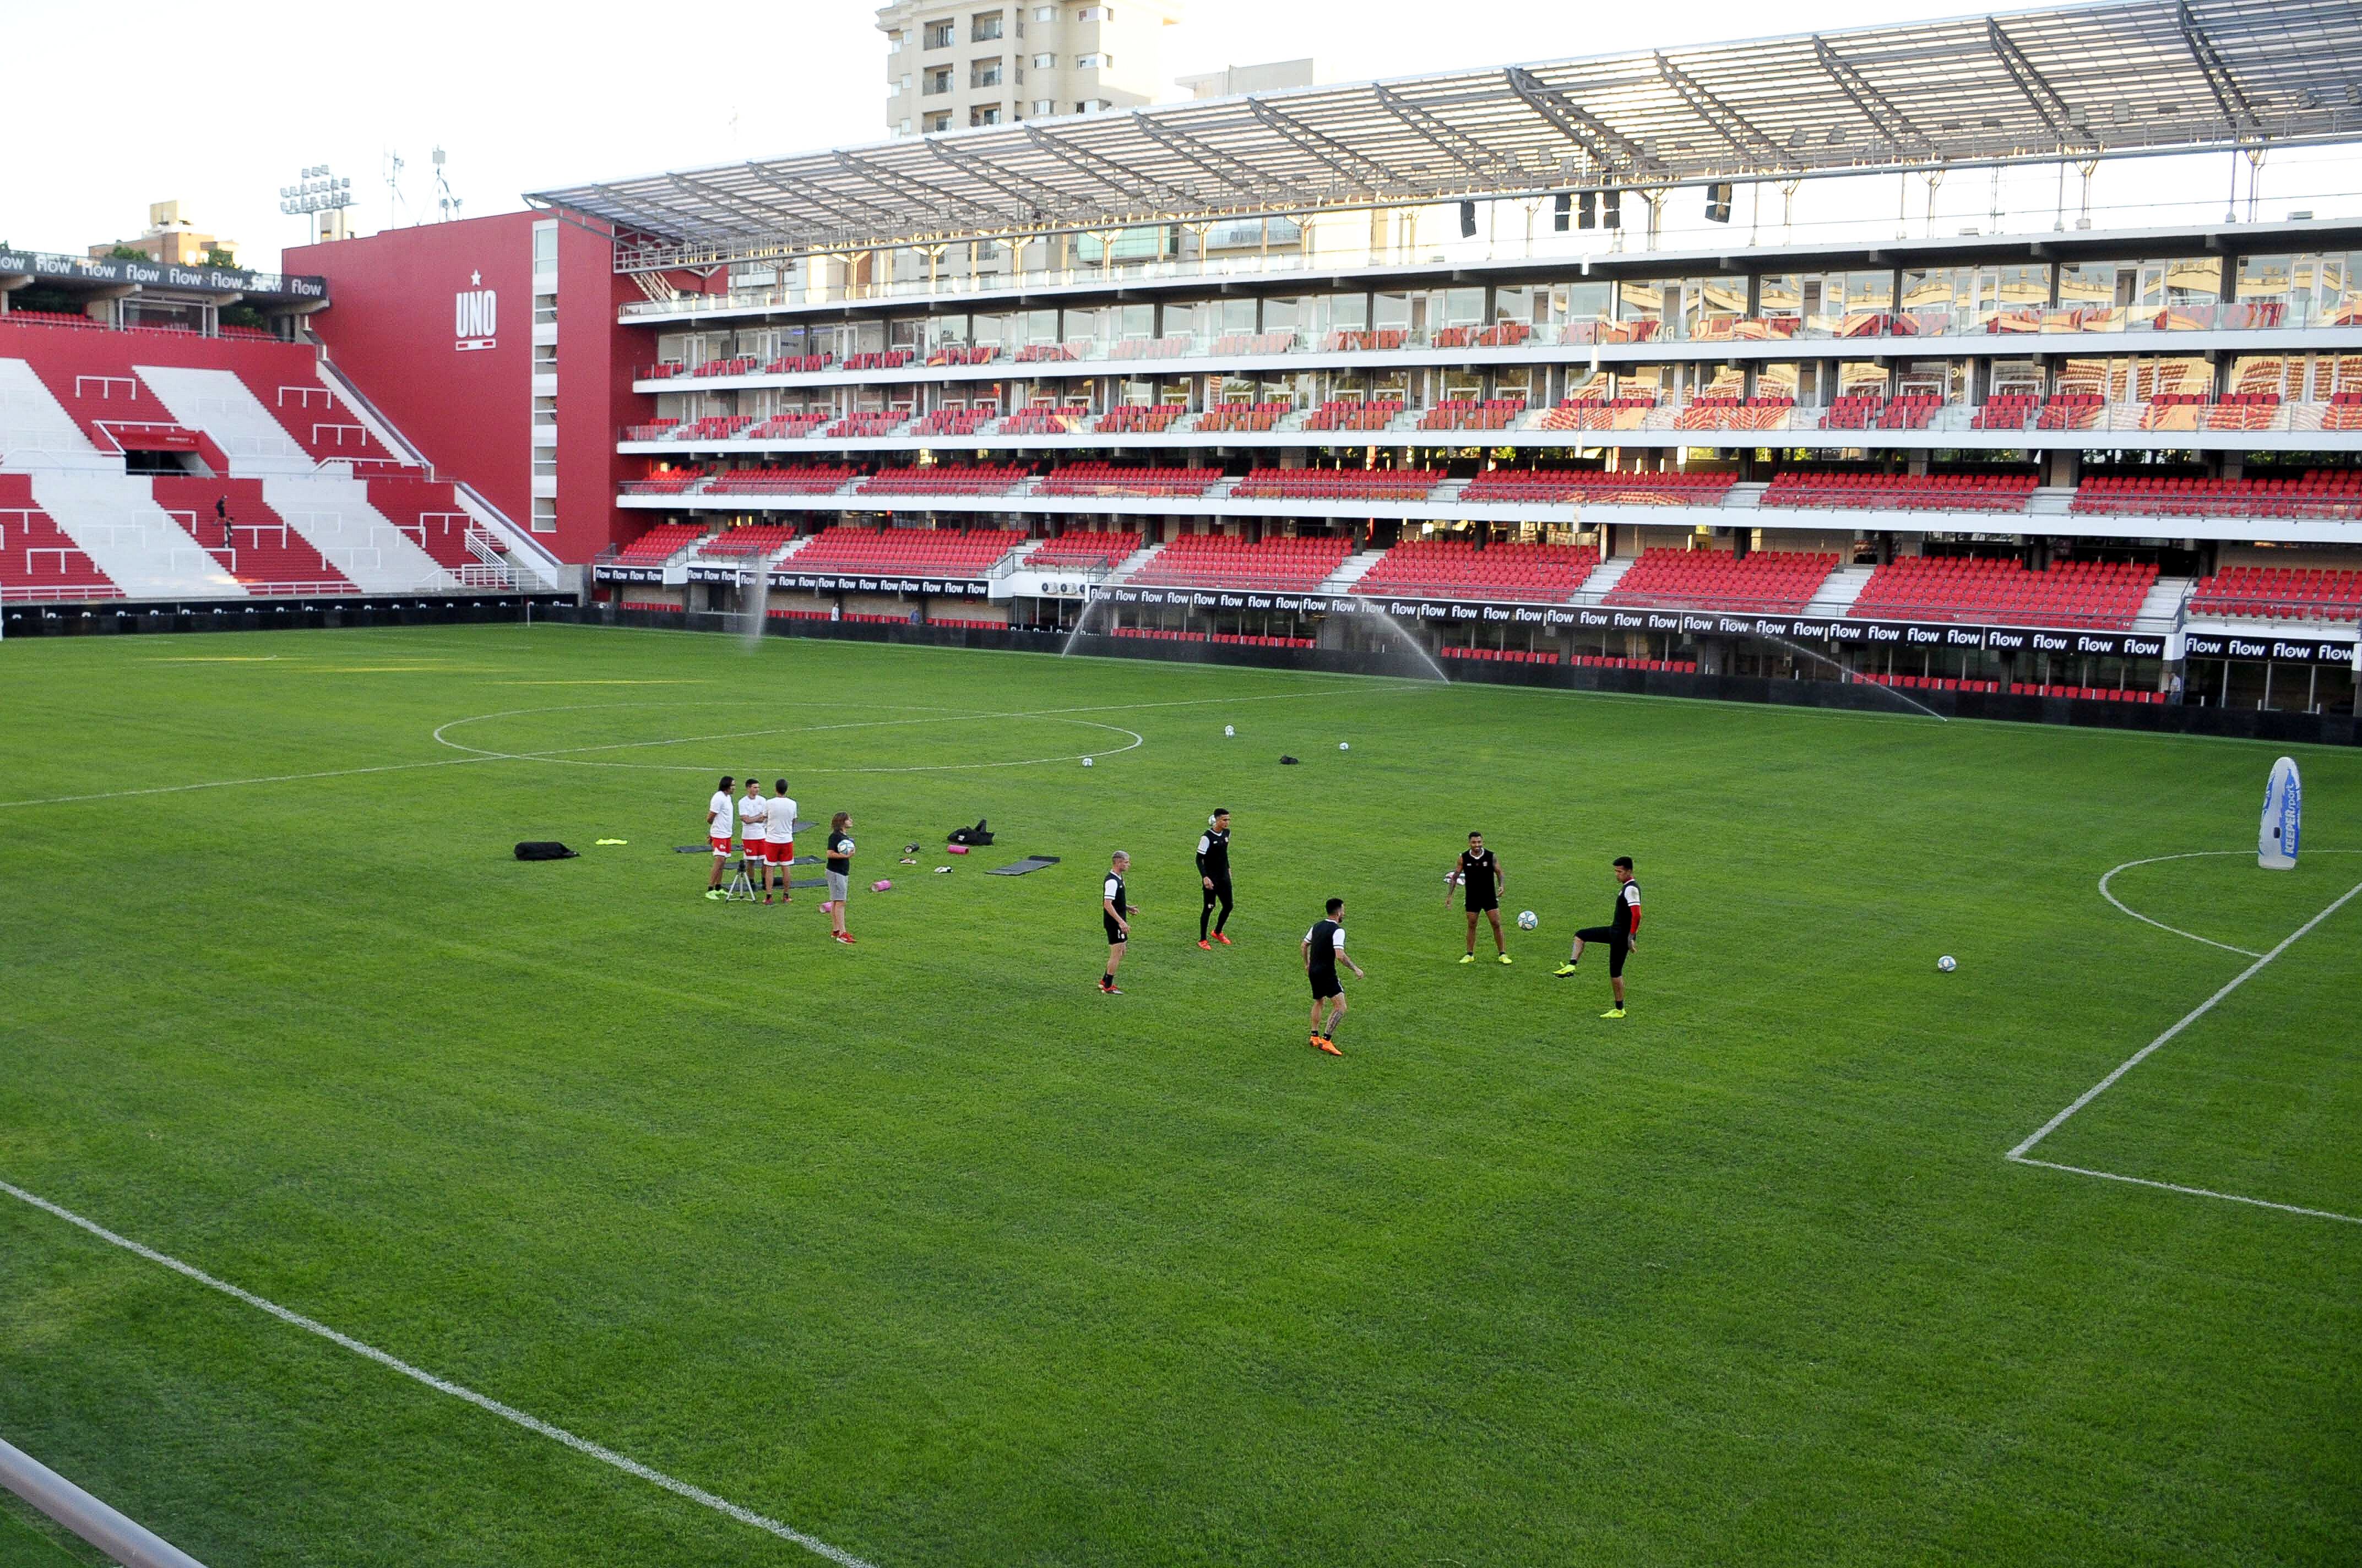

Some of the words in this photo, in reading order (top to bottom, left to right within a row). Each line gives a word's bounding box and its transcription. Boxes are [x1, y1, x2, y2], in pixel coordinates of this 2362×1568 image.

[0, 255, 25, 269] ow
[35, 254, 72, 274] flow
[126, 264, 160, 282] flow
[169, 268, 202, 285] flow
[211, 271, 243, 289] flow
[291, 278, 322, 296] flow
[456, 290, 496, 337] UNO
[629, 570, 644, 580] flow
[704, 570, 719, 580] flow
[779, 576, 796, 586] flow
[799, 576, 816, 587] flow
[818, 577, 835, 588] flow
[838, 578, 856, 589] flow
[859, 579, 877, 590] flow
[881, 580, 899, 591] flow
[901, 580, 919, 591] flow
[922, 581, 941, 592] flow
[944, 582, 964, 594] flow
[967, 584, 987, 594] flow
[1116, 590, 1137, 601] flow
[1141, 591, 1163, 602] flow
[1167, 592, 1189, 603] flow
[1193, 593, 1216, 605] flow
[1220, 595, 1242, 606] flow
[1248, 596, 1270, 608] flow
[1276, 597, 1300, 609] flow
[1303, 598, 1327, 611] flow
[1332, 600, 1355, 612] flow
[1391, 602, 1416, 615] flow
[1421, 603, 1446, 617] flow
[1452, 605, 1477, 618] flow
[1484, 607, 1509, 620] flow
[1516, 608, 1542, 622] flow
[1547, 609, 1574, 624] flow
[1580, 611, 1608, 625] flow
[1614, 613, 1642, 627] flow
[1649, 614, 1677, 629] flow
[1684, 616, 1713, 631] flow
[1719, 618, 1749, 633] flow
[1756, 619, 1785, 635] flow
[1793, 622, 1824, 637] flow
[1829, 623, 1861, 639] flow
[1868, 625, 1900, 641] flow
[1907, 627, 1940, 643] flow
[1947, 629, 1980, 645] flow
[1989, 630, 2023, 647] flow
[2033, 634, 2067, 650] flow
[2078, 636, 2113, 652] flow
[2124, 638, 2159, 655] flow
[2186, 638, 2221, 654] flow
[2228, 639, 2265, 656] flow
[2273, 642, 2310, 659] flow
[2318, 644, 2354, 661] flow
